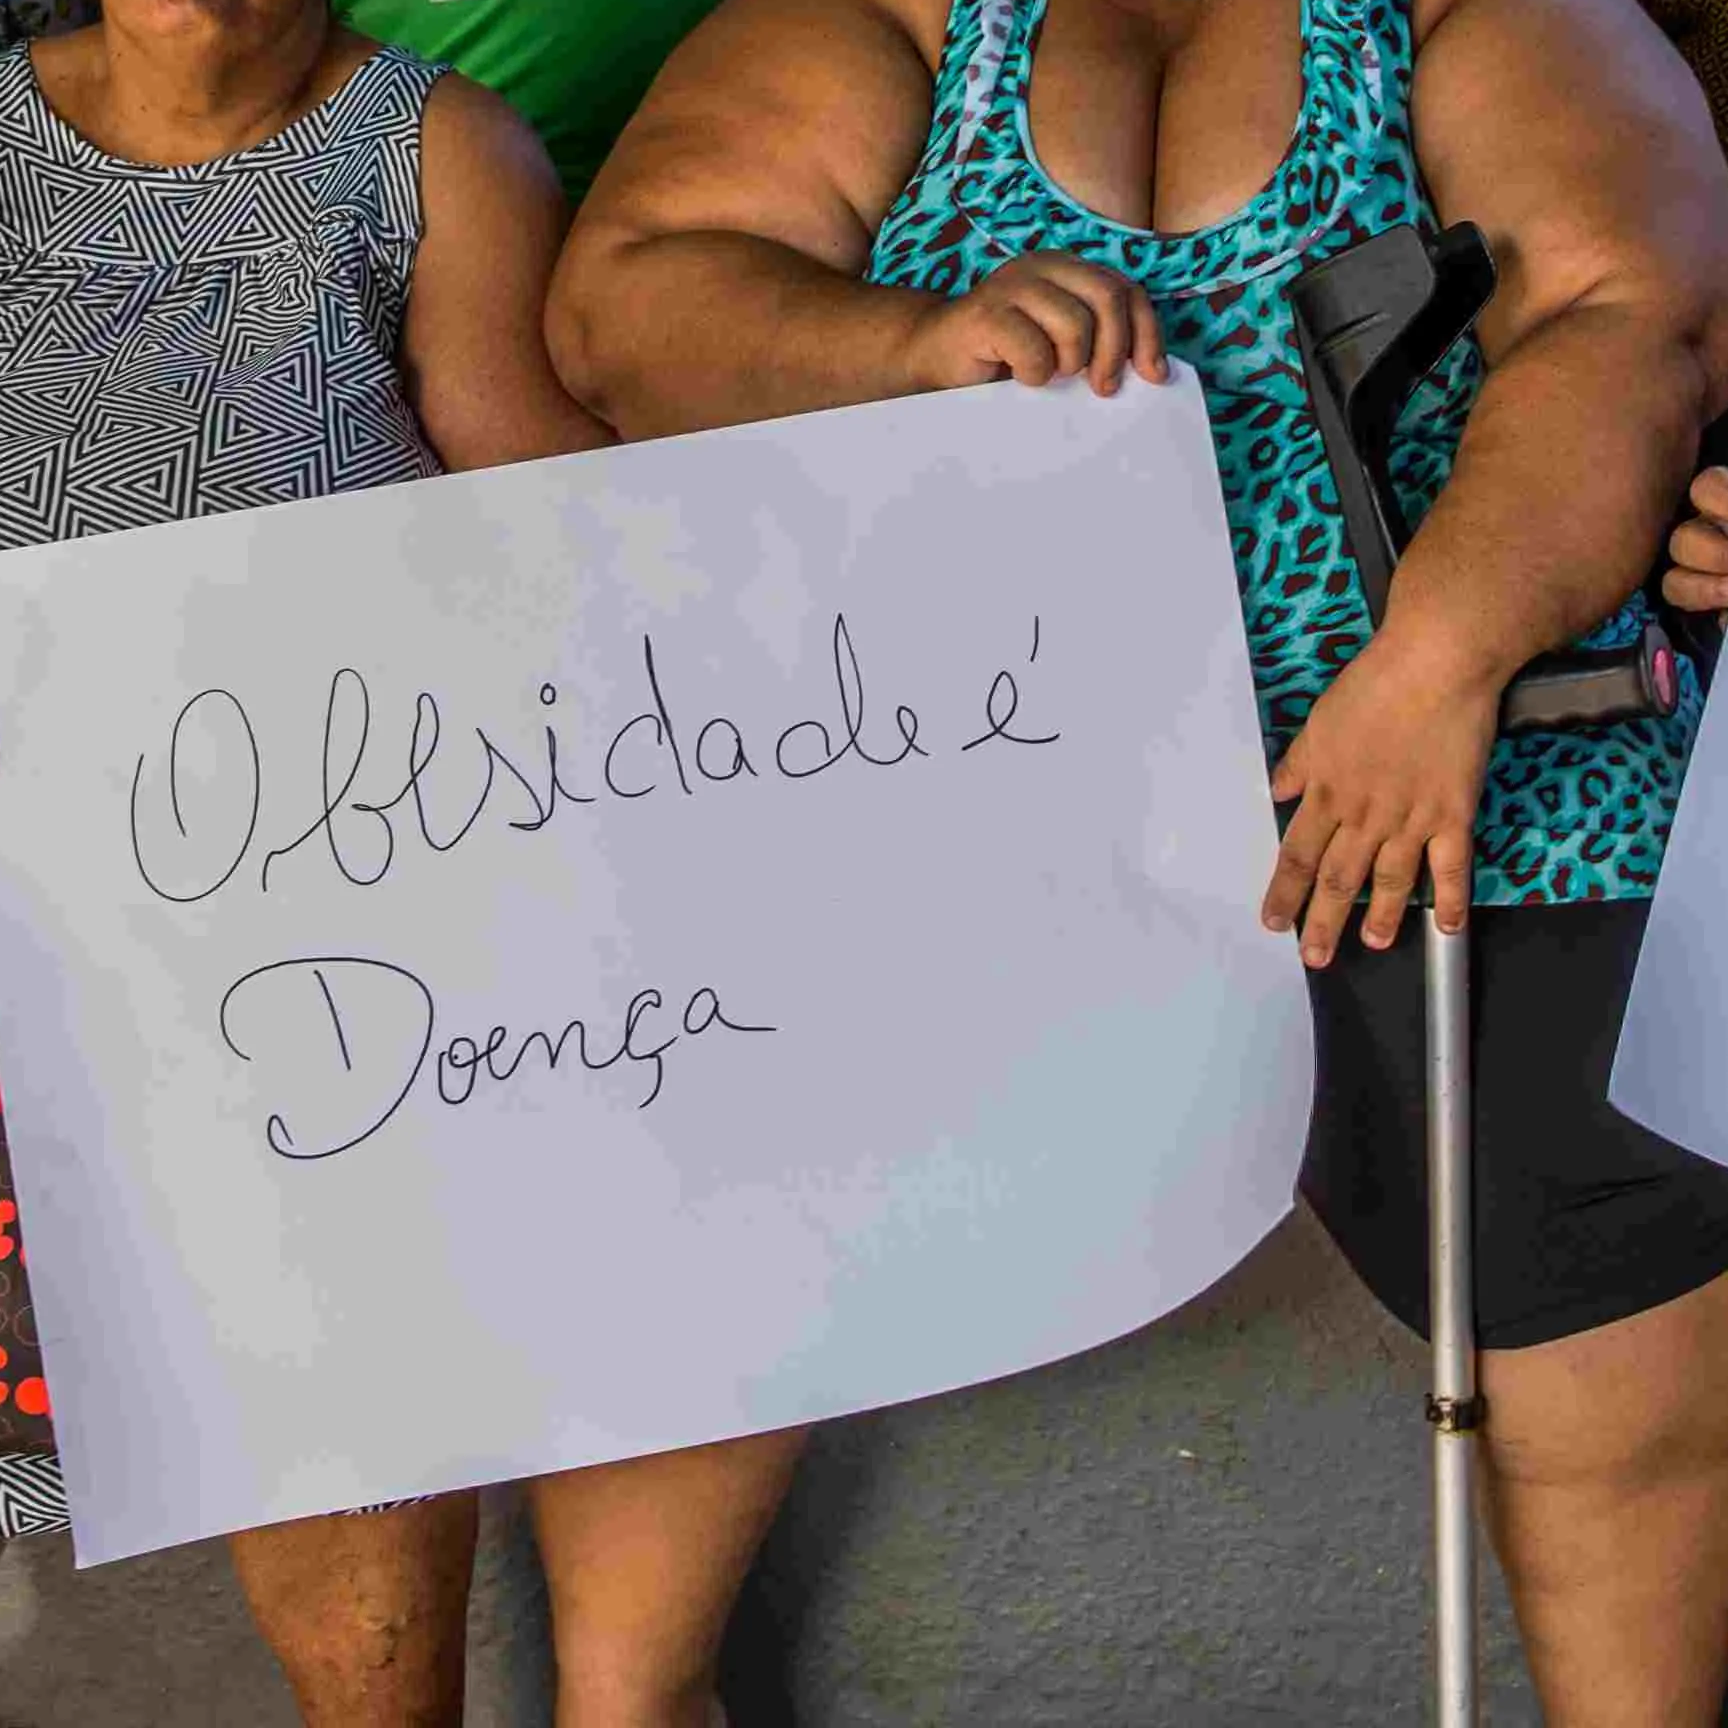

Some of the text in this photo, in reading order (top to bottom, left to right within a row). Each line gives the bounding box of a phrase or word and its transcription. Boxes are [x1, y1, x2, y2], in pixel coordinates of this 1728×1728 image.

[131, 613, 1060, 902] Obesidade é
[220, 957, 777, 1160] Doença
